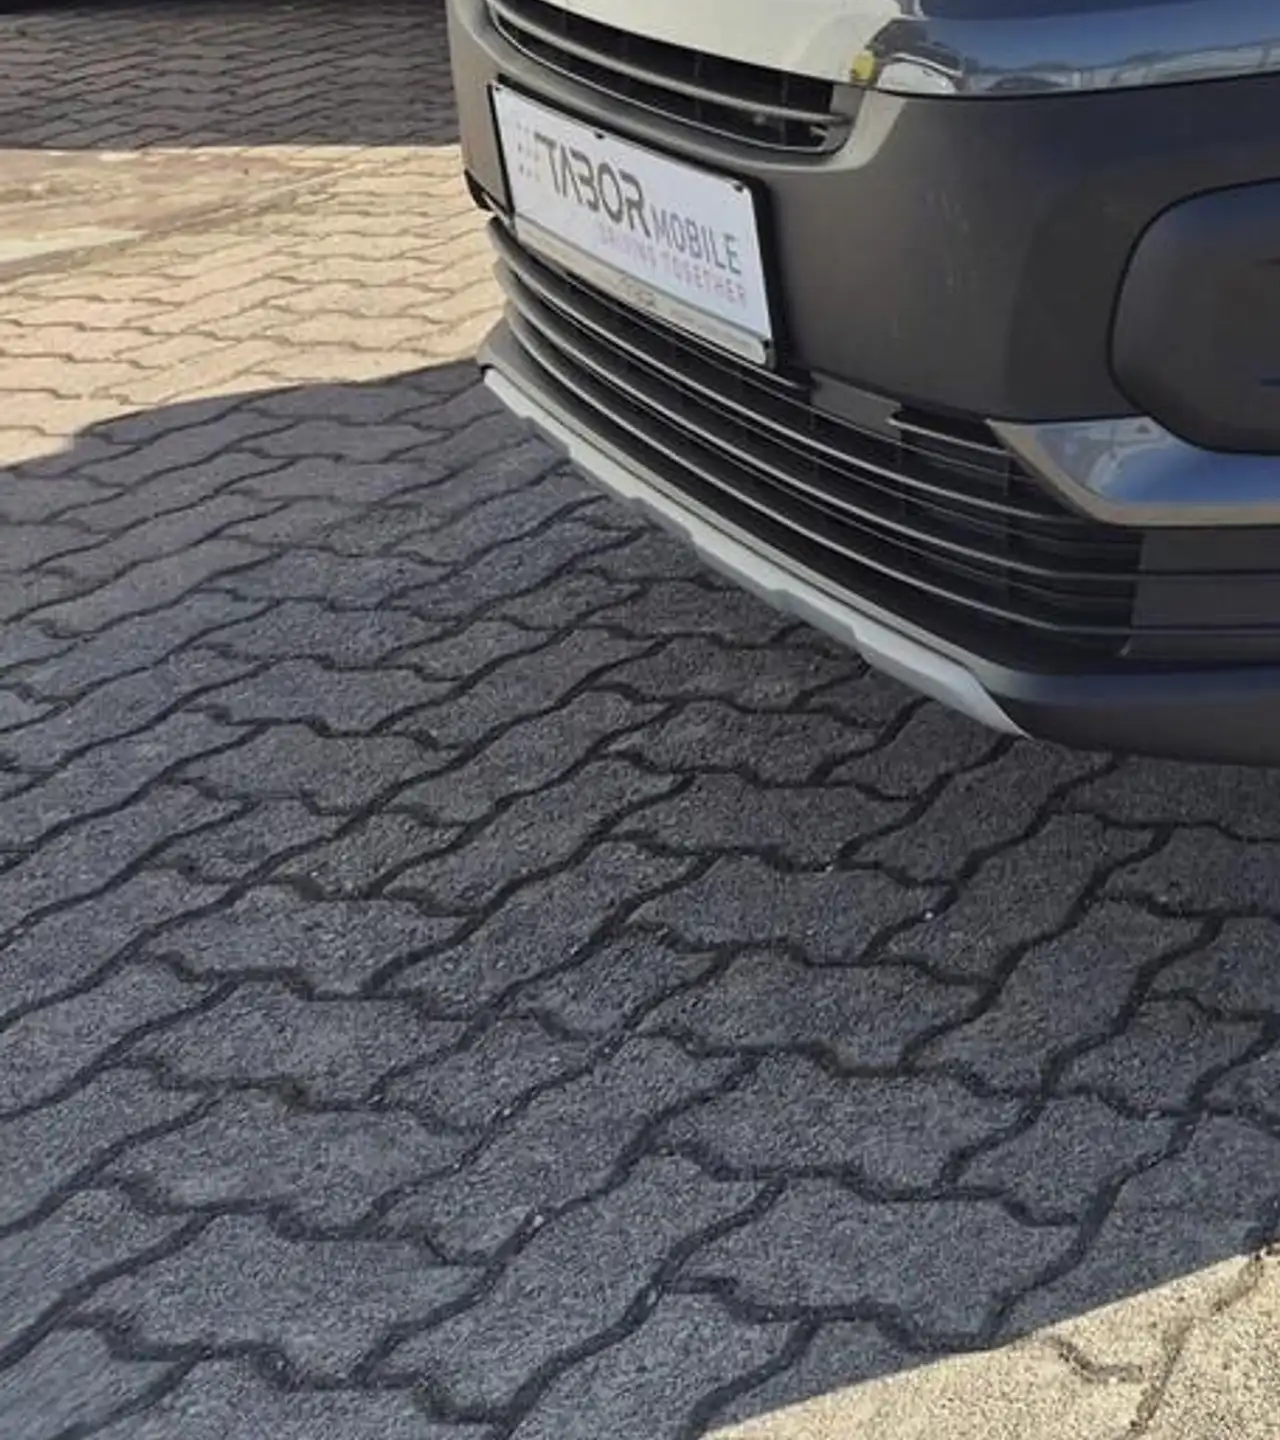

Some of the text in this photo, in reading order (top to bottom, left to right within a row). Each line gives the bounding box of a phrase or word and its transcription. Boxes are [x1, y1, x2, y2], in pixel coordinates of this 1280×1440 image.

[533, 131, 742, 276] TABOR MOBILE
[661, 248, 748, 306] TOGETHER
